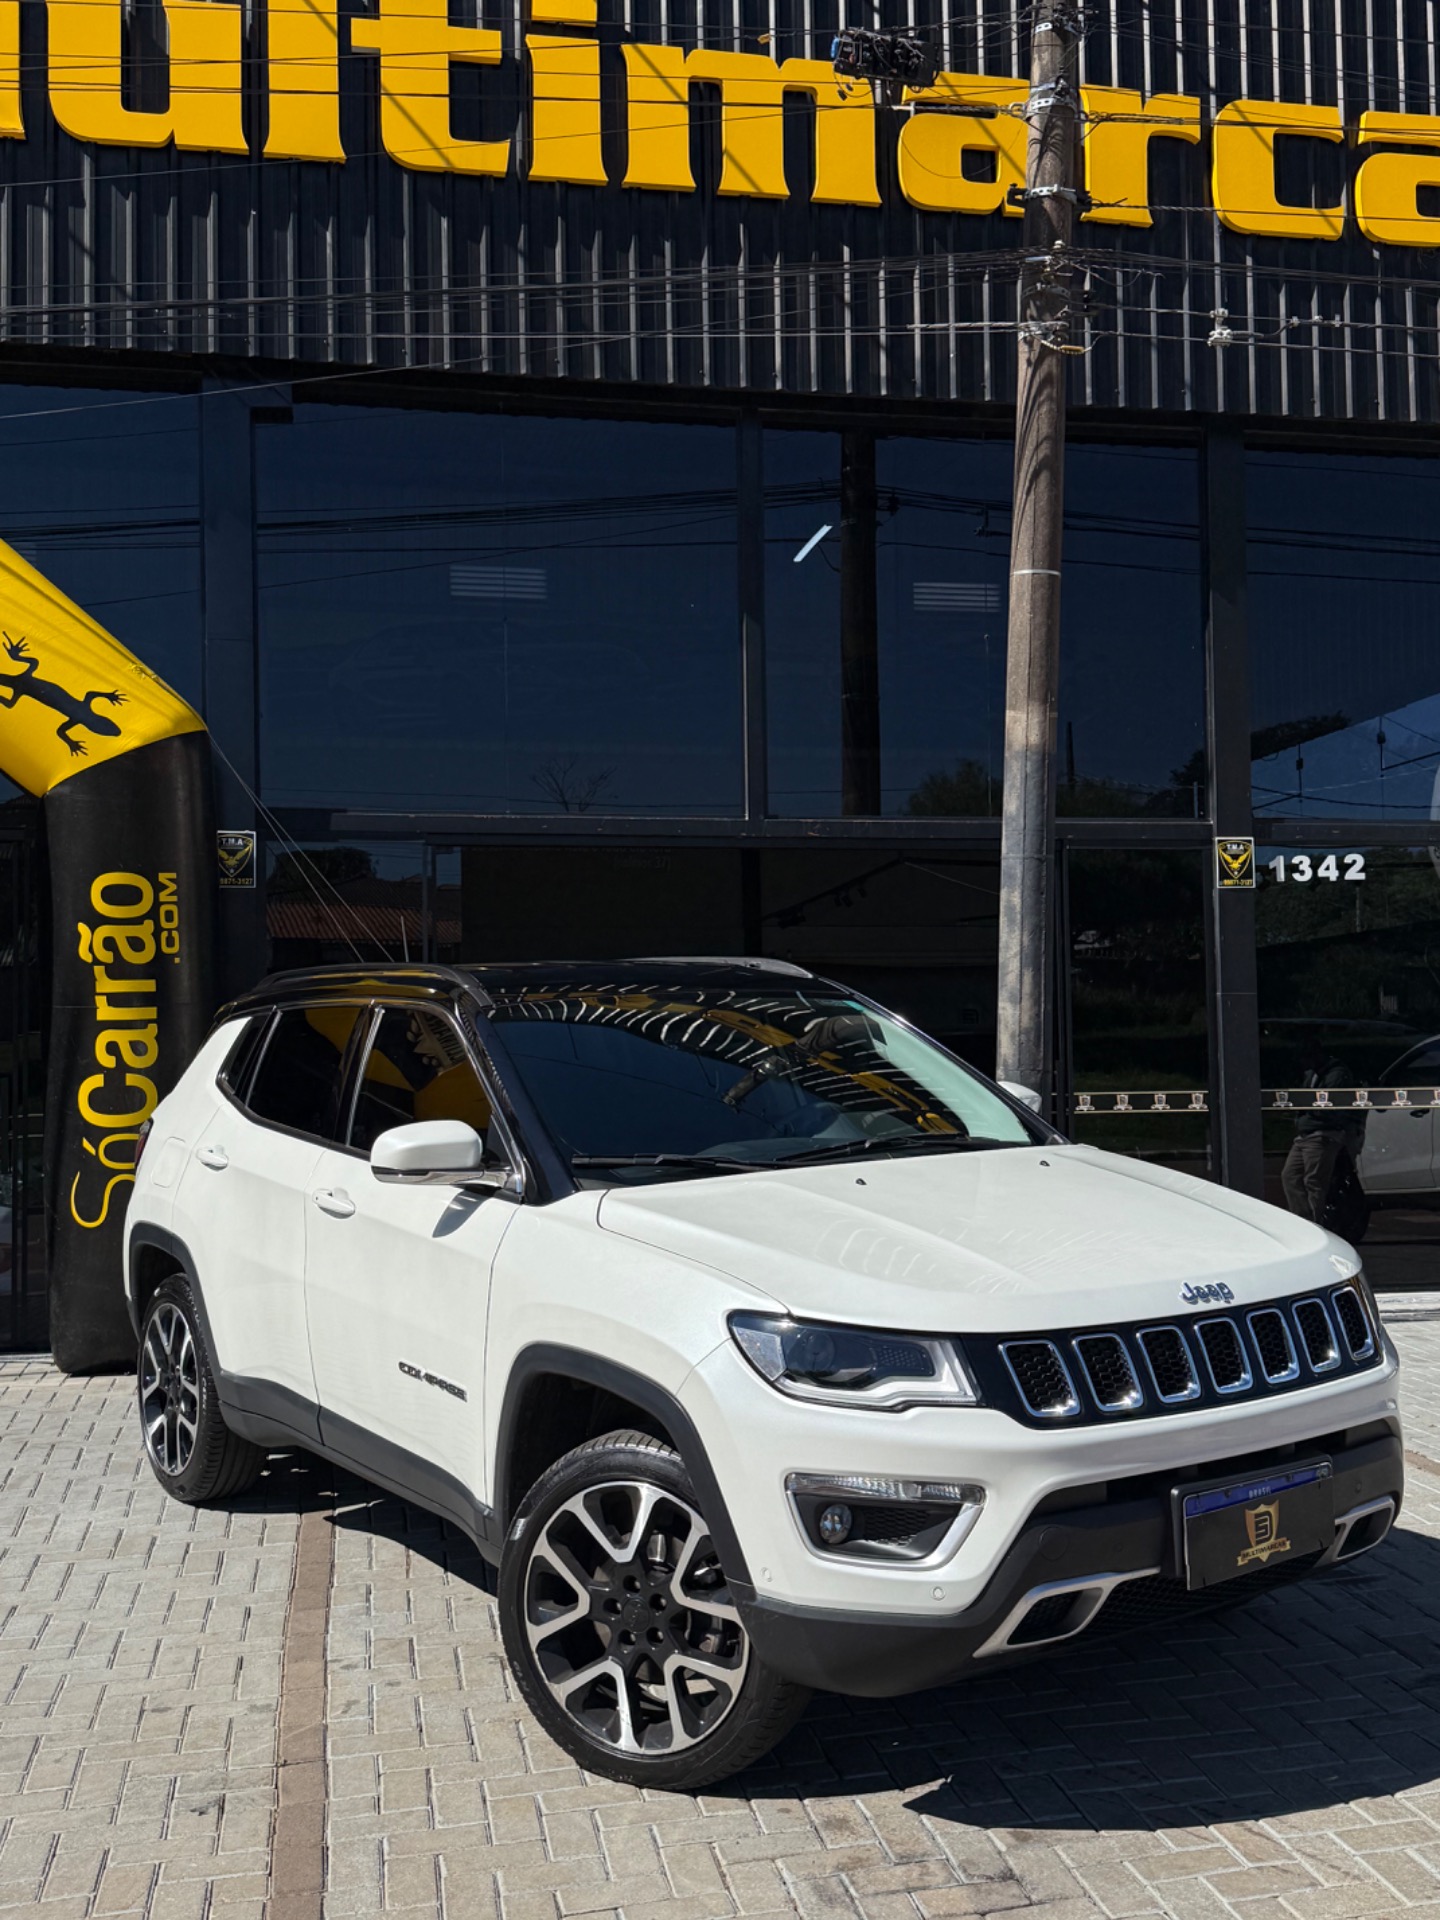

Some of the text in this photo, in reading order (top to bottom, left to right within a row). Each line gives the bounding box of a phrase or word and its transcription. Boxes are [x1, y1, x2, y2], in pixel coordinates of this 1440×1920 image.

[0, 0, 1440, 247] ultimarca
[1268, 853, 1366, 882] 1342
[159, 872, 180, 964] .COM
[1181, 1281, 1235, 1305] Jeep
